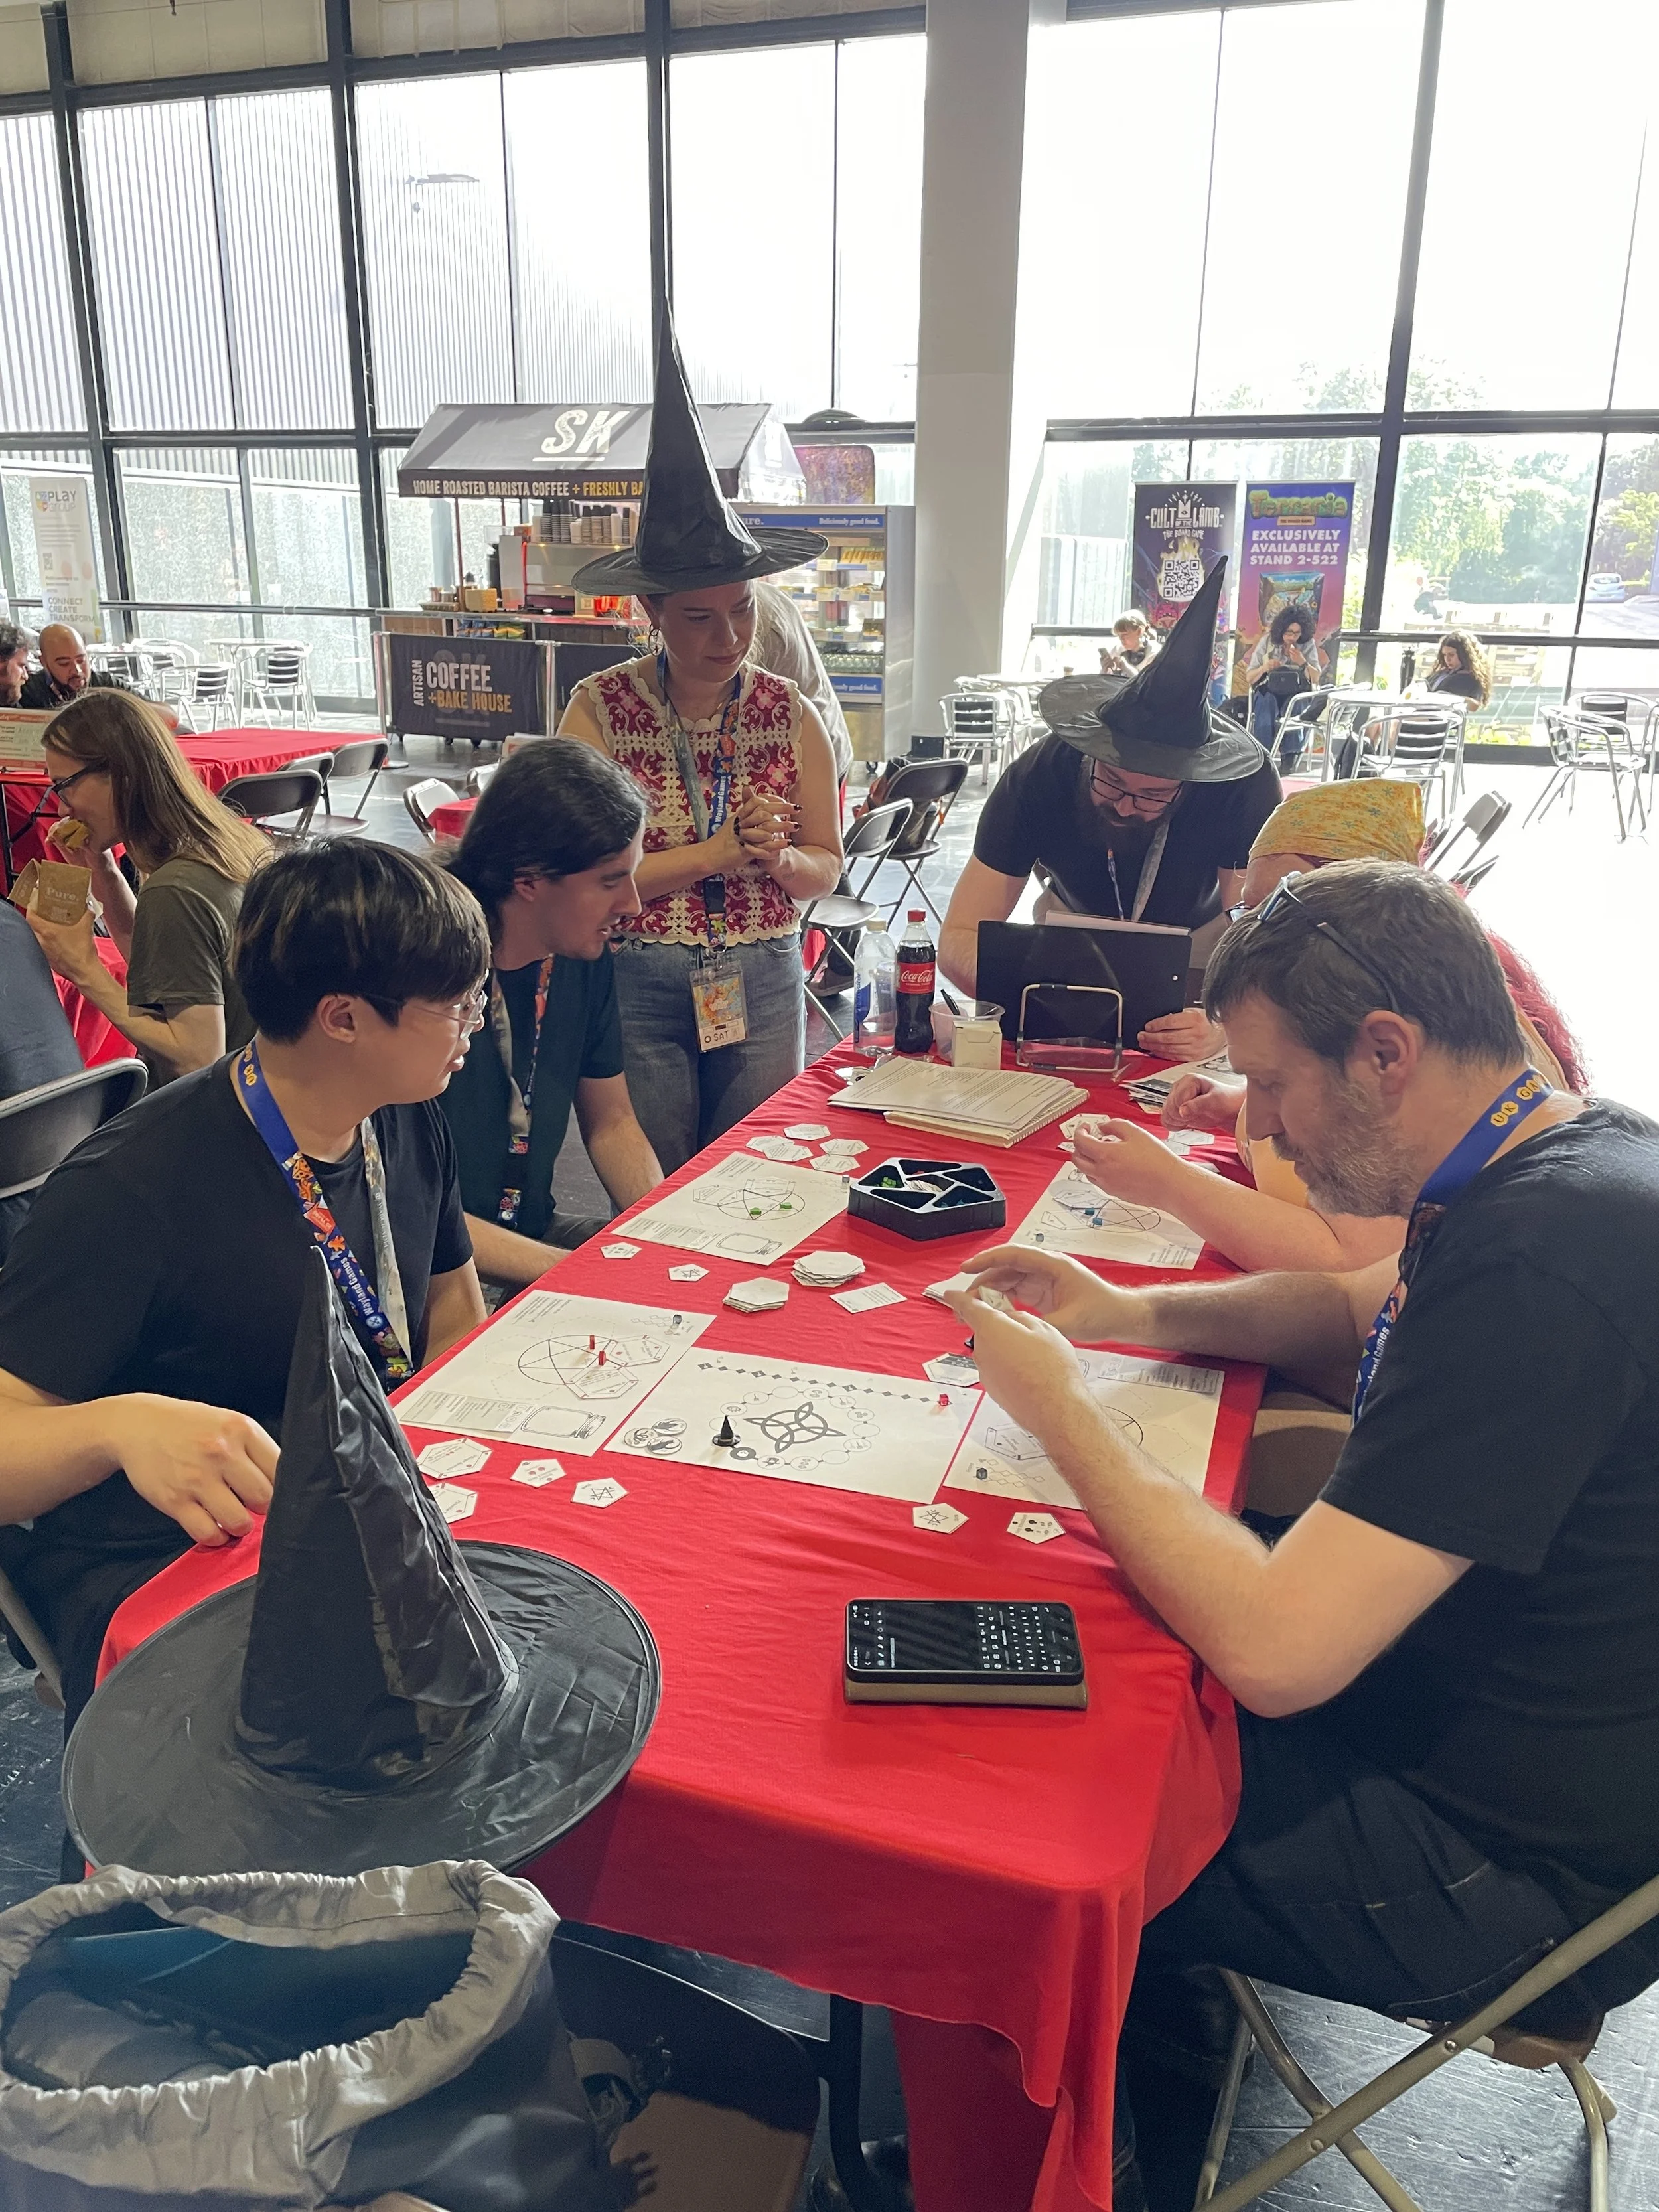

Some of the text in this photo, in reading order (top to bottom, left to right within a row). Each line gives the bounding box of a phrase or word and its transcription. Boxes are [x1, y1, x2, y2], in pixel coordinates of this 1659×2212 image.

[541, 410, 630, 454] SK
[413, 480, 644, 496] HOME ROASTED BARISTA COFFEE + FRESHLY BA
[1250, 490, 1348, 518] Terraria
[1151, 508, 1177, 528] CULT
[1193, 507, 1220, 528] LAMB
[1163, 530, 1173, 540] THE
[1252, 530, 1340, 540] EXCLUSIVELY
[1250, 543, 1340, 553] AVAILABLE AT
[1250, 555, 1338, 565] STAND 2-522
[412, 660, 425, 707] ARTISAN
[426, 661, 492, 692] COFFEE
[472, 693, 513, 713] HOUSE
[715, 775, 727, 822] Wayland Games
[713, 1030, 729, 1041] SAT
[1492, 1081, 1539, 1124] UK GA
[340, 1256, 375, 1317] Wayland Games
